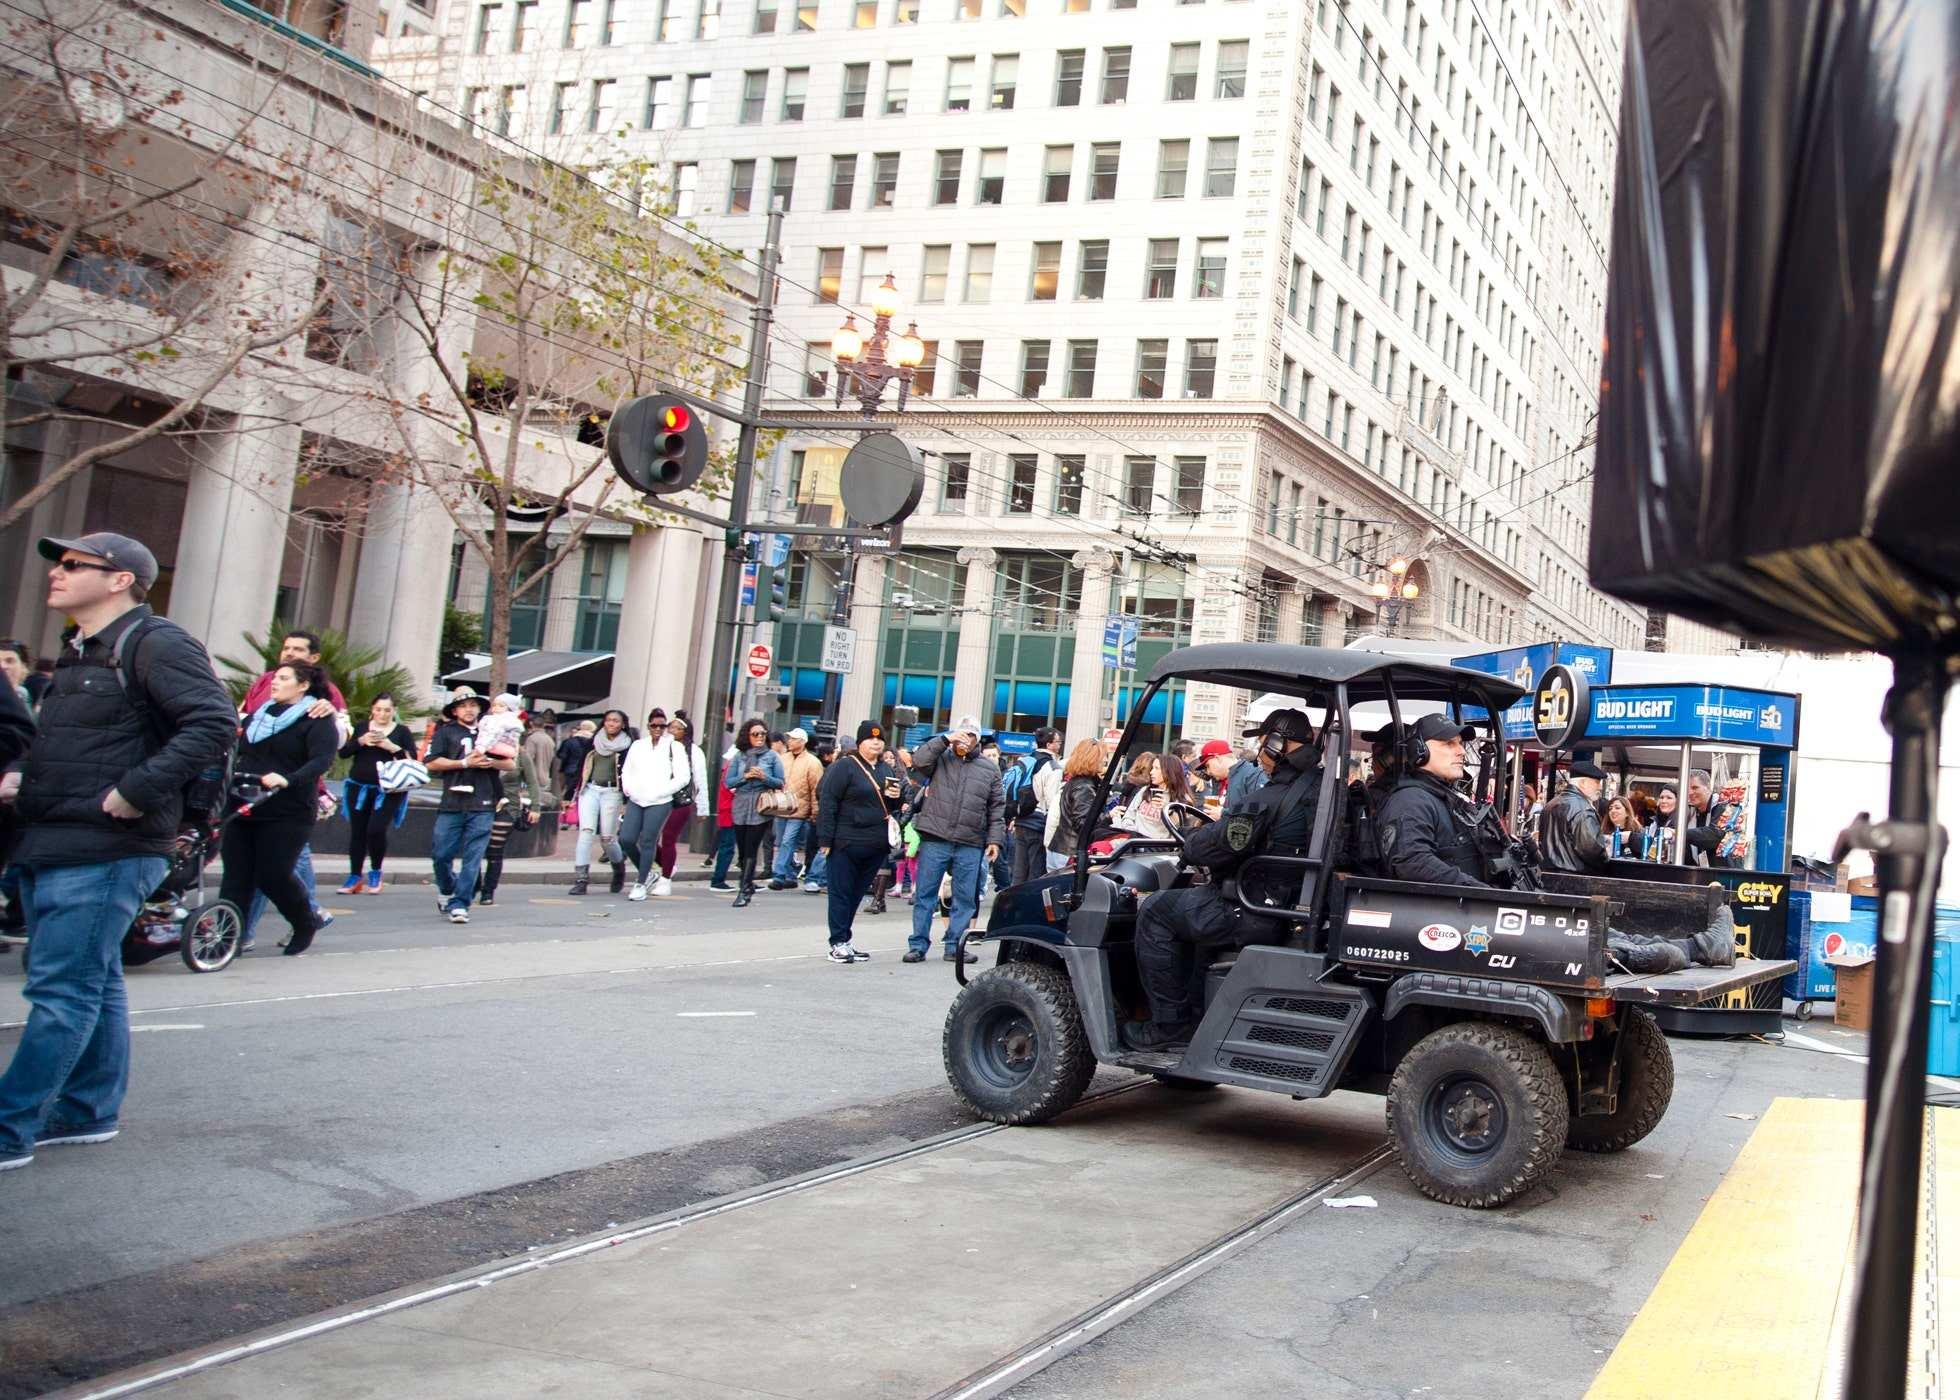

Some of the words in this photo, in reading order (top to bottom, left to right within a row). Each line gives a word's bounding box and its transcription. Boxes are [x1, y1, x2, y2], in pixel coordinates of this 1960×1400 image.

[835, 631, 847, 641] NO
[830, 642, 850, 652] RIGHT
[830, 651, 848, 660] TURN
[824, 659, 835, 668] ON
[836, 660, 850, 670] RED
[1538, 687, 1570, 724] 50
[1597, 702, 1626, 719] BUD
[1627, 700, 1673, 718] LIGHT
[1696, 705, 1722, 718] BUD
[1723, 708, 1753, 721] LIGHT
[1737, 882, 1784, 904] CITY
[1346, 946, 1410, 961] 060722025
[1488, 954, 1516, 969] CU
[1814, 984, 1830, 993] LIVE
